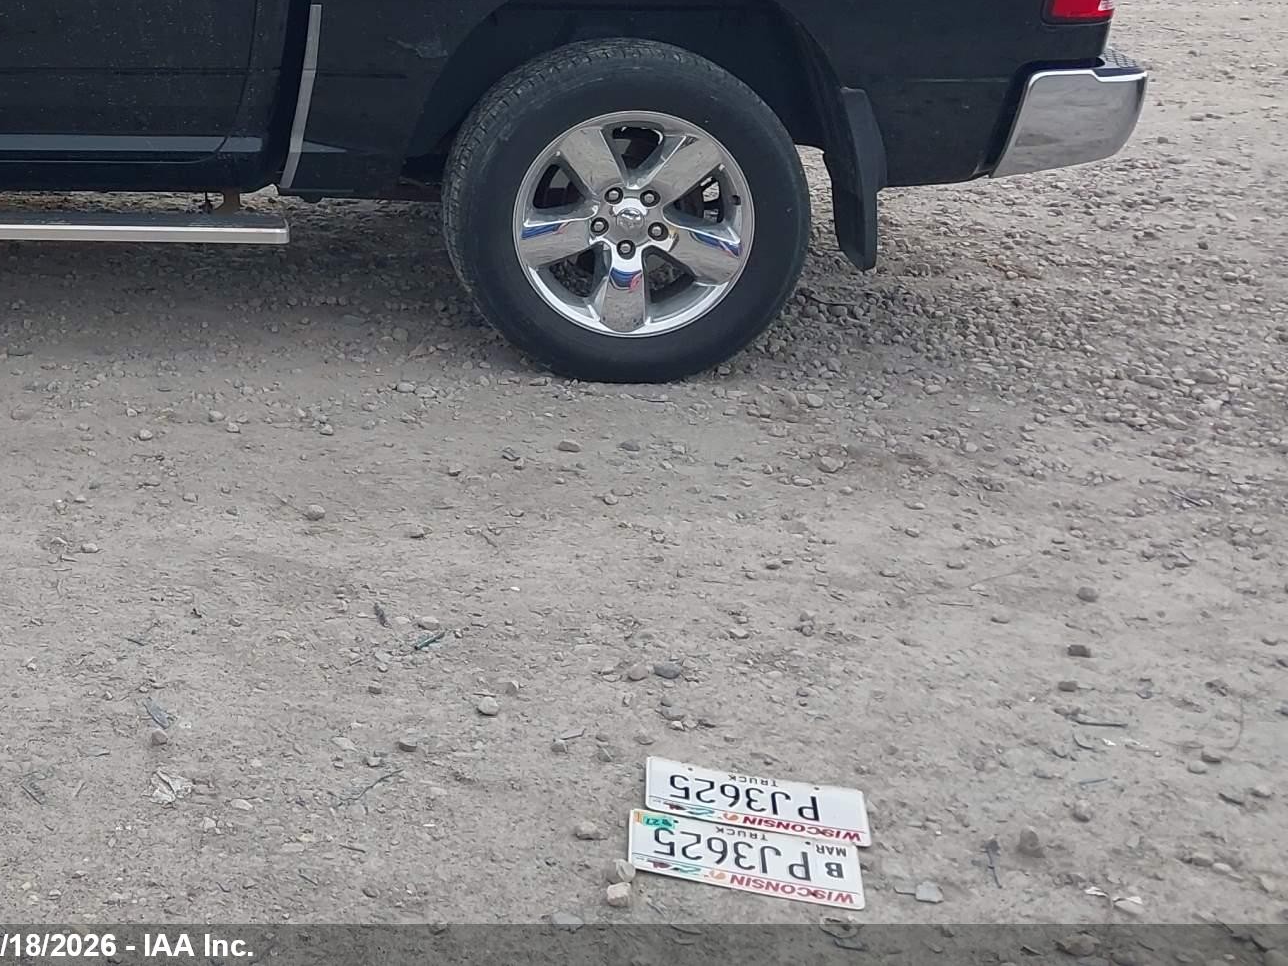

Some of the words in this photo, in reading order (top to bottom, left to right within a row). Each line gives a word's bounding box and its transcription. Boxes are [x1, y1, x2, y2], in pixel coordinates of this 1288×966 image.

[727, 773, 779, 788] TRUCK
[669, 773, 821, 822] PJ3625
[715, 825, 769, 842] TRUCK
[741, 815, 861, 843] WISCONSIN
[815, 843, 848, 858] MAR
[824, 860, 845, 879] B
[729, 873, 854, 905] WISCONSIN
